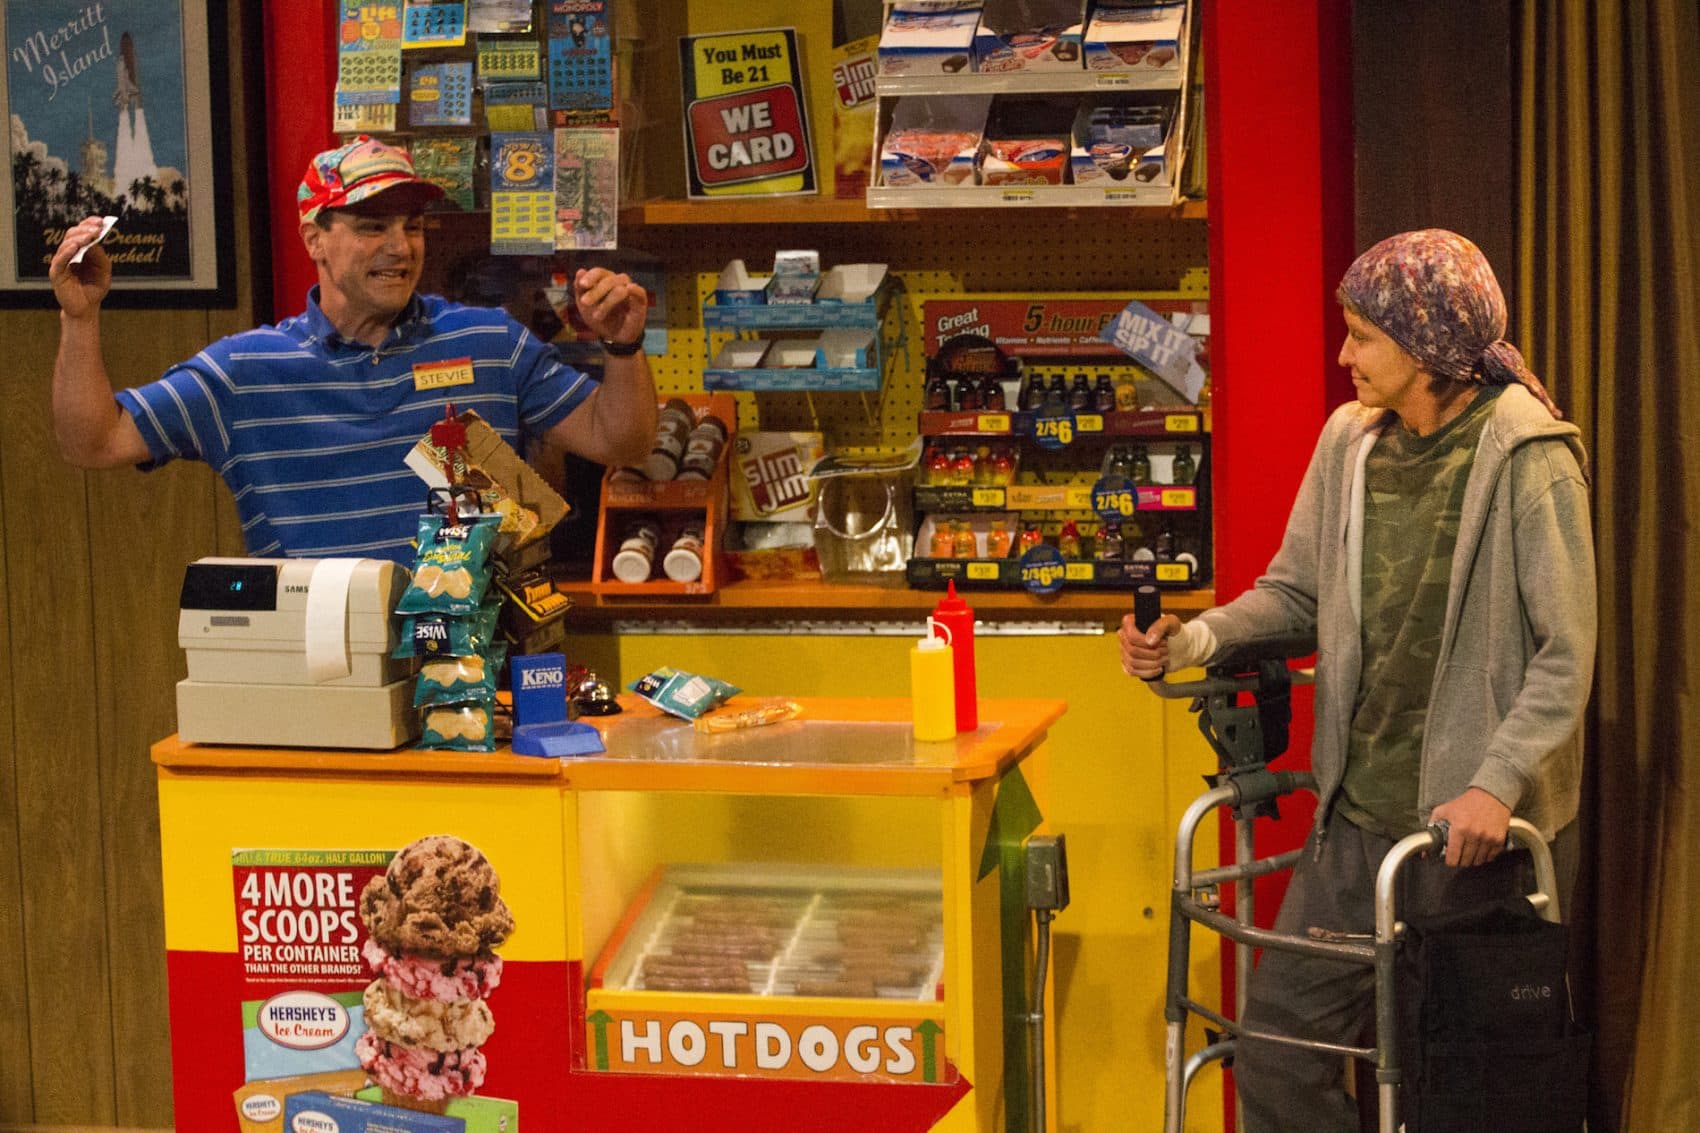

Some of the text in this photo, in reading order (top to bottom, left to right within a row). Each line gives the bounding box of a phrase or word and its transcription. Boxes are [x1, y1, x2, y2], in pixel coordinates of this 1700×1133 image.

[12, 3, 105, 73] Merritt
[704, 43, 782, 63] You Must
[42, 25, 112, 101] Island
[721, 66, 770, 85] Be 21
[720, 101, 773, 134] WE
[707, 132, 795, 170] CARD
[104, 229, 165, 245] Dreams
[938, 307, 979, 332] Great
[1119, 309, 1163, 343] MIX
[1163, 328, 1190, 350] IT
[1115, 328, 1177, 366] SIP IT
[420, 370, 470, 386] STEVIE
[1035, 419, 1073, 444] 2/$6
[745, 453, 802, 486] slim
[415, 626, 448, 640] WISE
[521, 668, 564, 687] KENO
[326, 853, 346, 864] HALF
[350, 853, 386, 864] GALLON!
[241, 872, 356, 908] 4 MORE
[241, 909, 359, 944] SCOOPS
[244, 945, 360, 962] PER CONTAINER
[245, 962, 269, 974] THAN
[271, 963, 288, 974] THE
[290, 963, 319, 975] OTHER
[1510, 983, 1551, 1001] drive
[270, 1007, 336, 1022] HERSHEY'S
[274, 1022, 334, 1037] Ice Cream
[297, 1117, 334, 1132] HERSHEY'S
